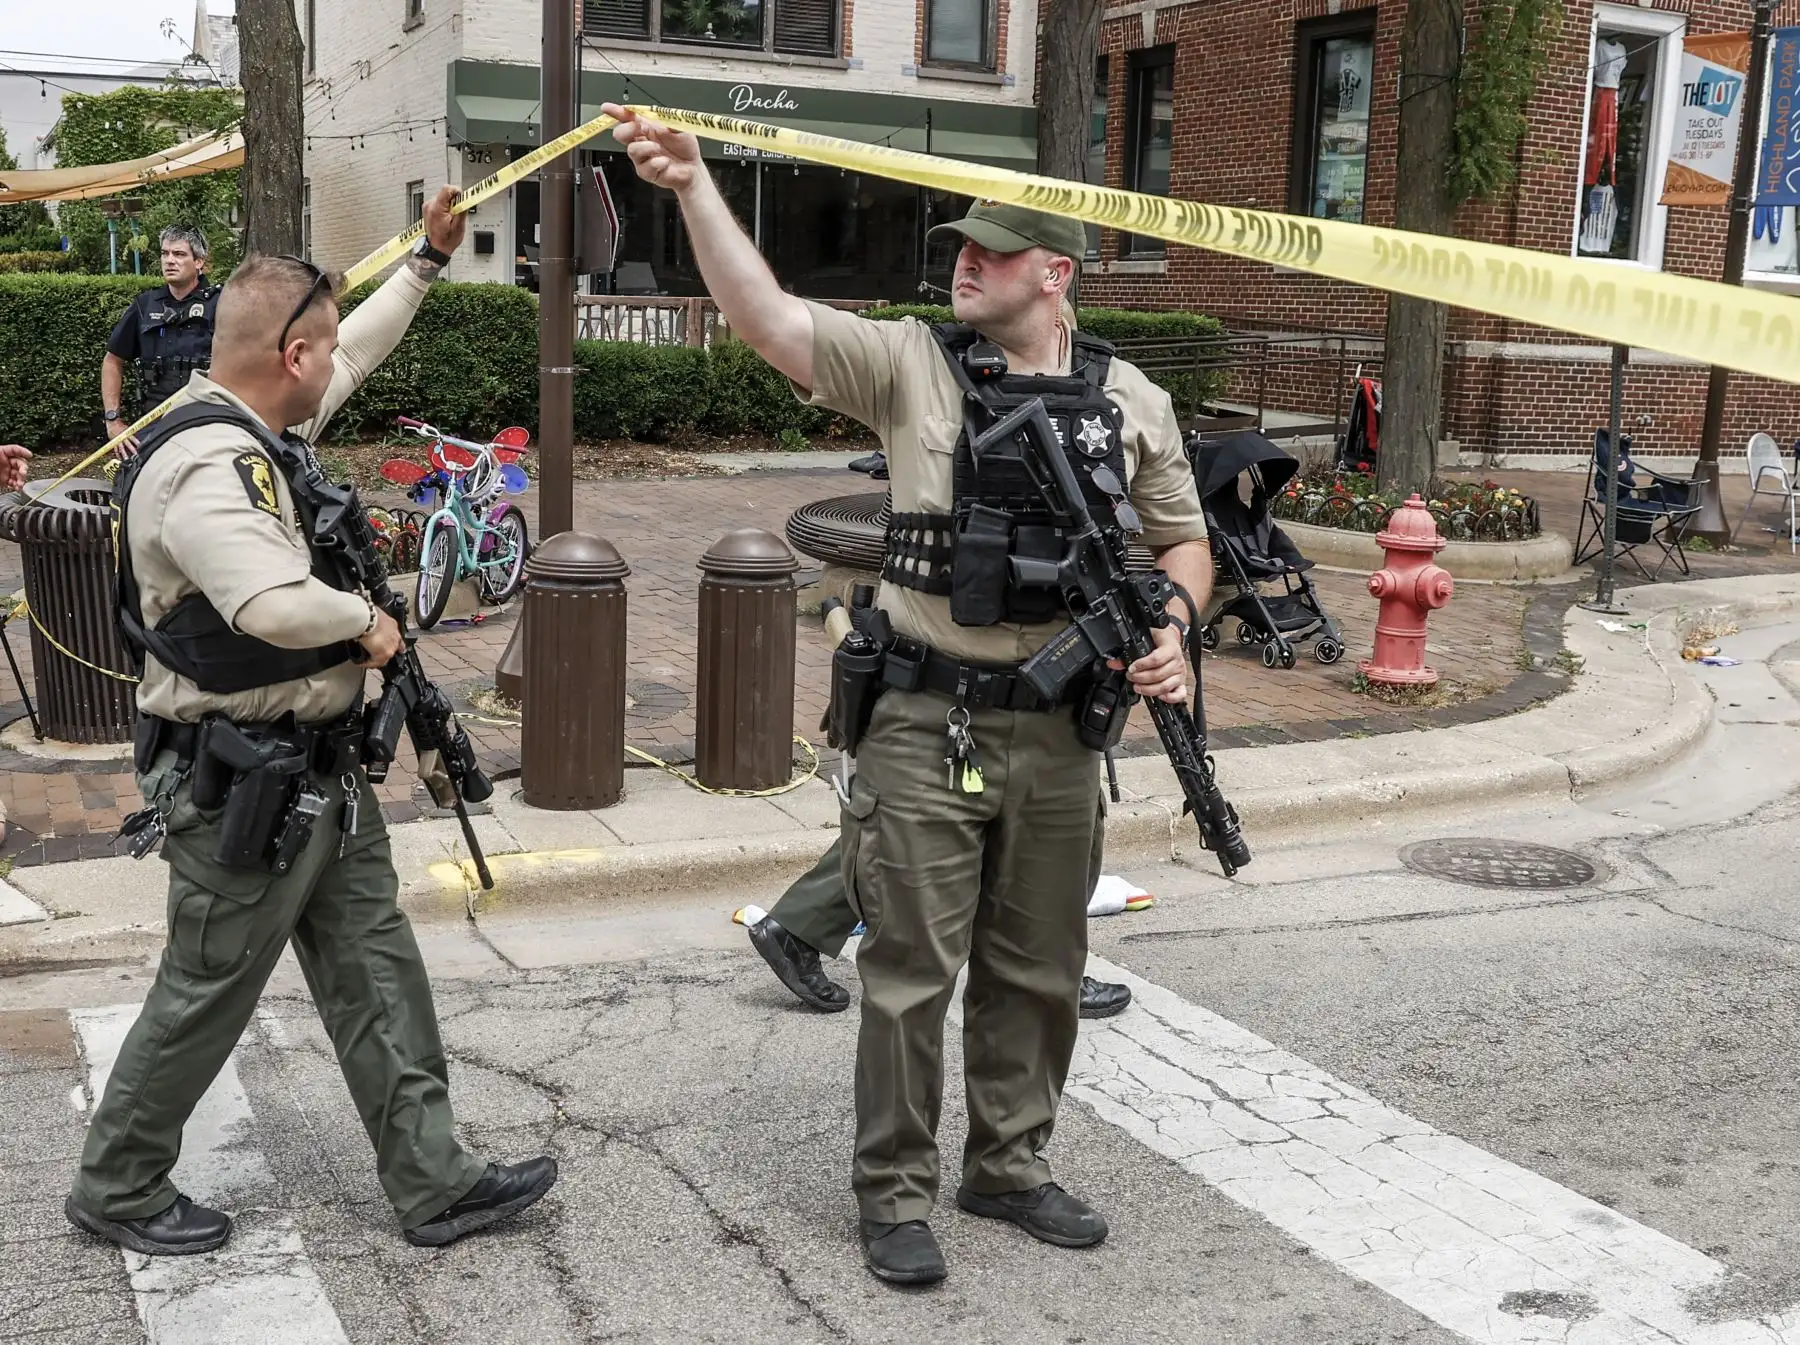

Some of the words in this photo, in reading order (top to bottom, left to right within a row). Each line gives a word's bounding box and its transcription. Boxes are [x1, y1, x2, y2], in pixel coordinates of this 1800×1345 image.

[728, 84, 799, 112] Dacha
[1688, 118, 1705, 128] TAKE
[1706, 117, 1724, 128] OUT
[1765, 96, 1791, 194] HIGHLAND
[1779, 40, 1797, 88] PARK
[1685, 129, 1723, 140] TUESDAYS
